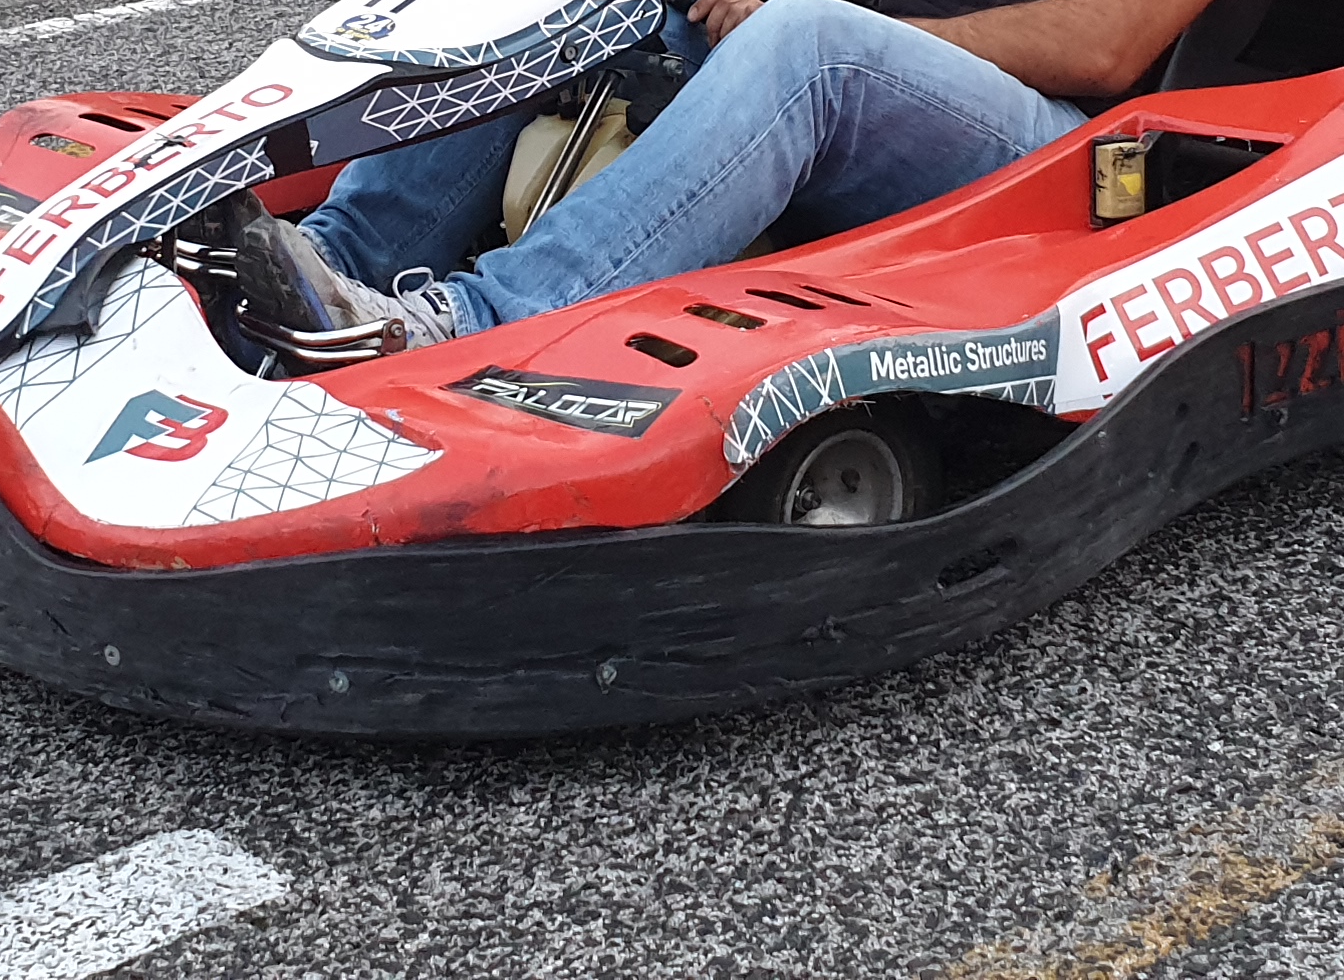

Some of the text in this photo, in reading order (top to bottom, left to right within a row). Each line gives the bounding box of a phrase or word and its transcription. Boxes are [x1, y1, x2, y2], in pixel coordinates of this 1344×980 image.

[868, 336, 1048, 382] Metallic Structures
[471, 377, 660, 425] PALOCAR
